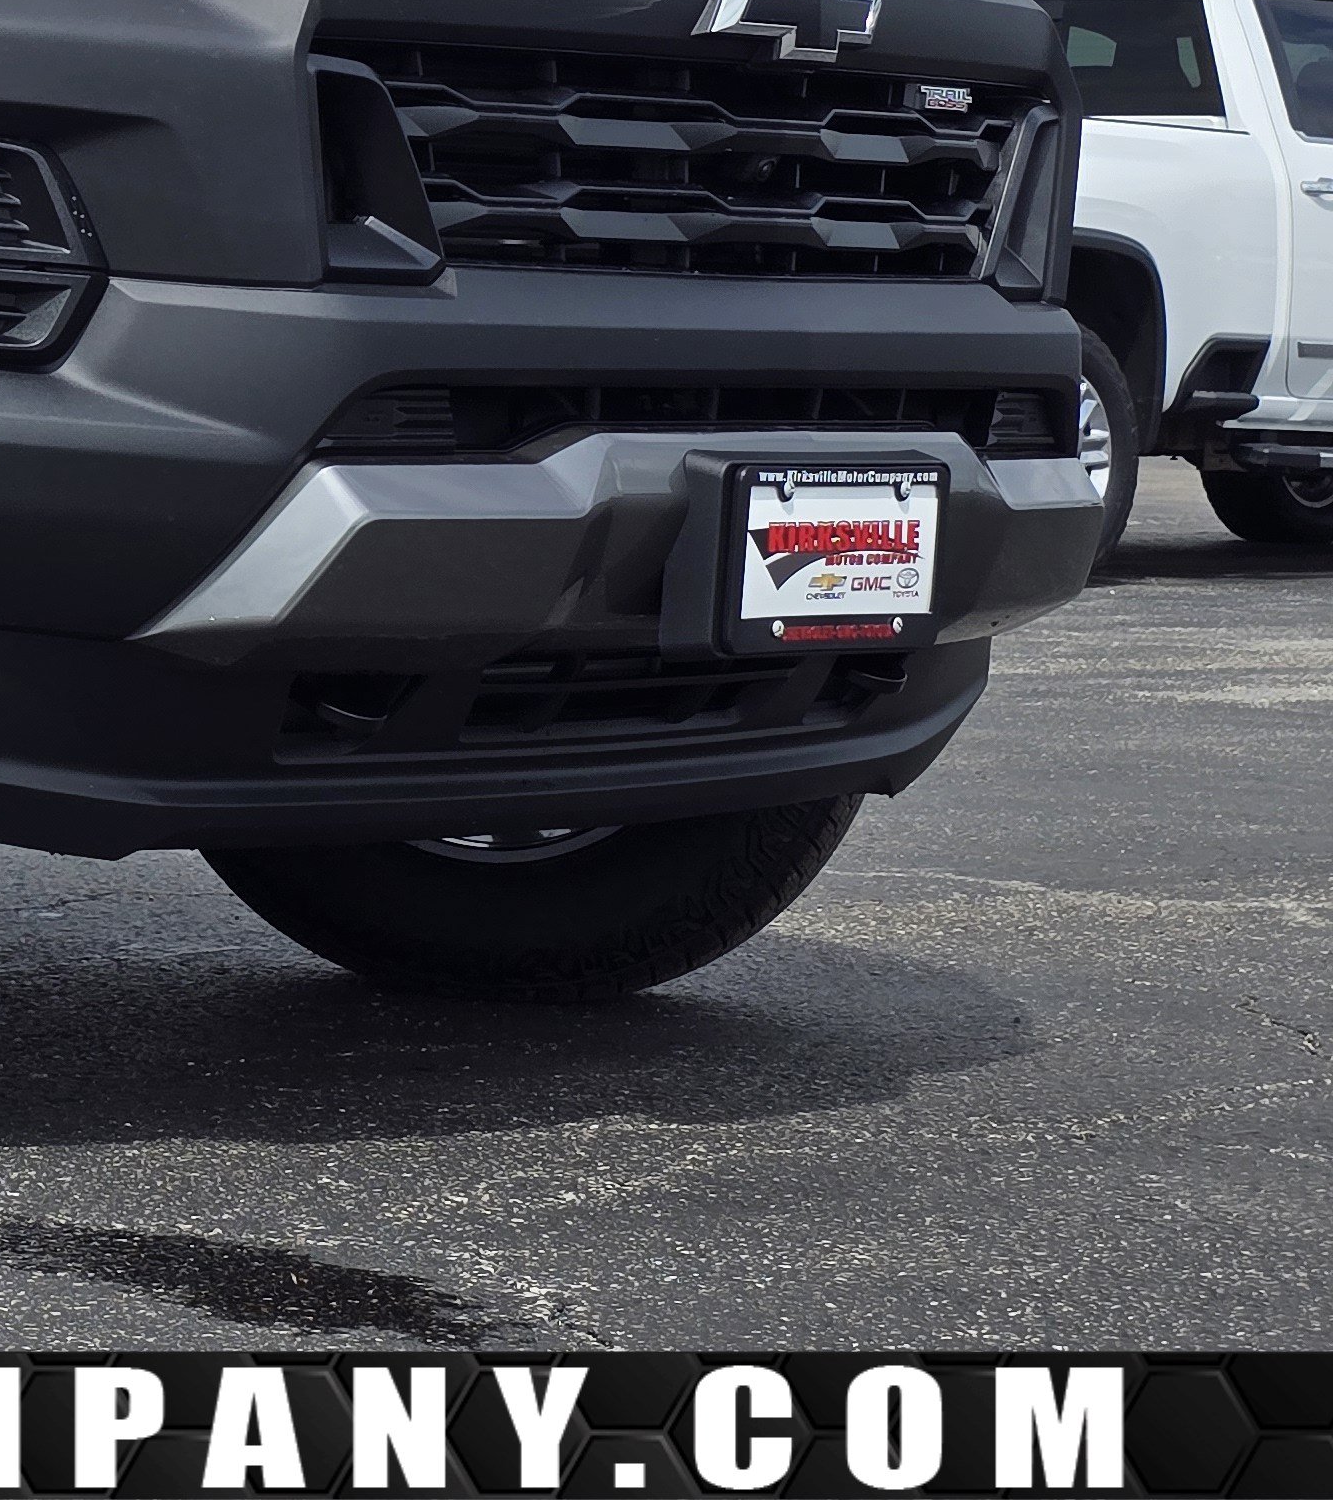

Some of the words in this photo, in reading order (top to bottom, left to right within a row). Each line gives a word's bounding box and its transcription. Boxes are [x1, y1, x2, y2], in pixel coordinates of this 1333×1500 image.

[920, 86, 972, 103] TRAIL
[767, 519, 921, 554] KIRKSVILLE
[824, 553, 864, 567] MOTOR
[850, 576, 892, 592] GMC
